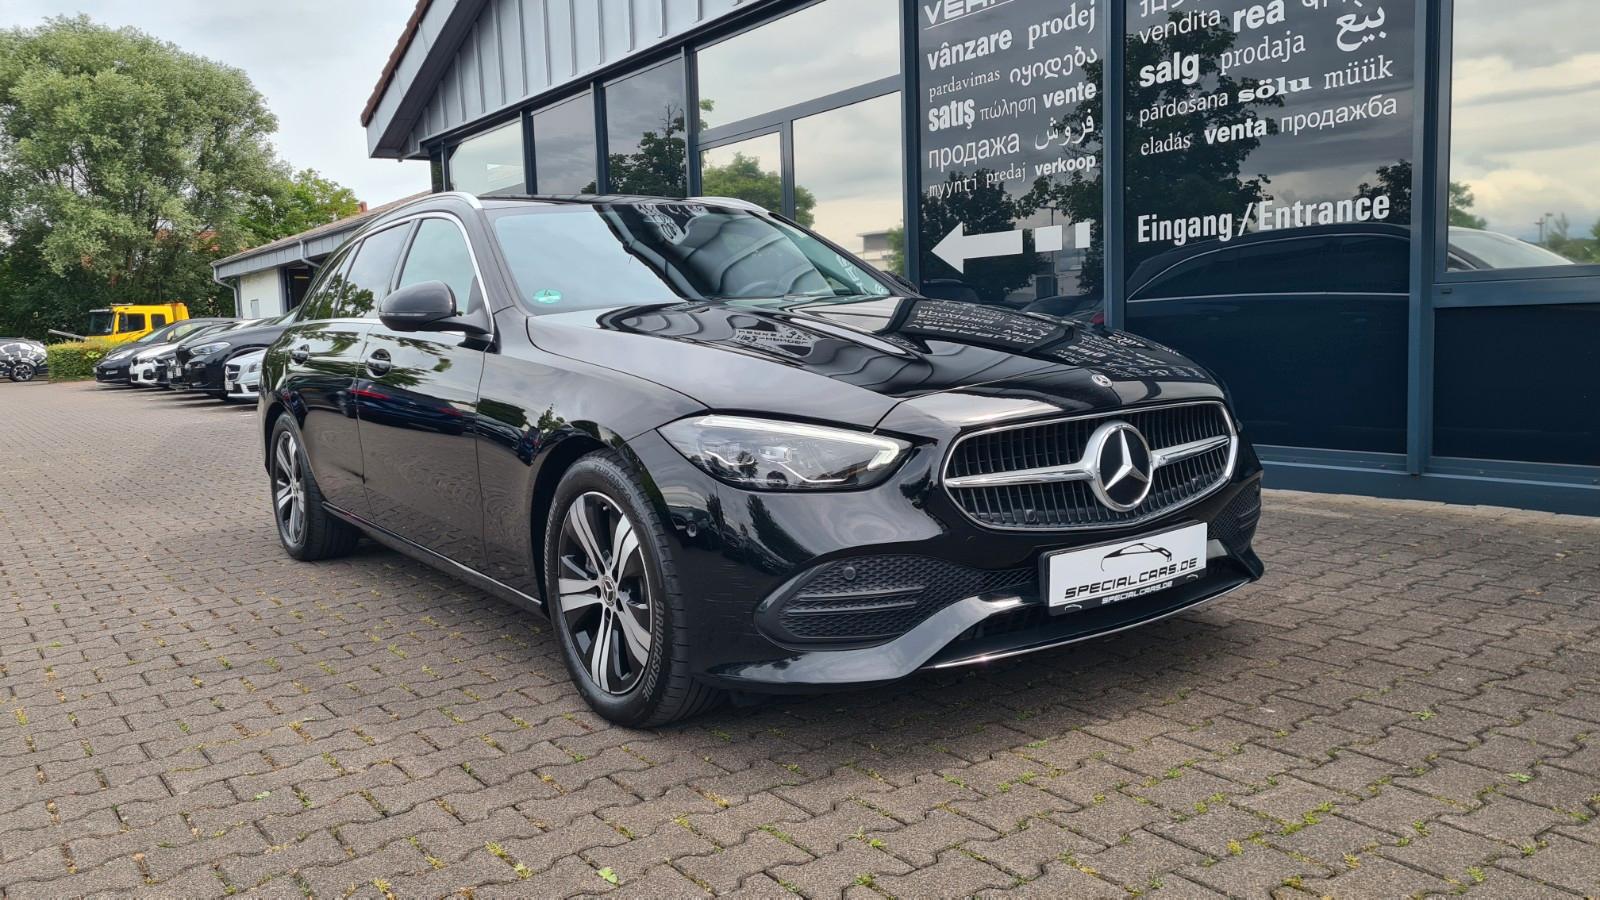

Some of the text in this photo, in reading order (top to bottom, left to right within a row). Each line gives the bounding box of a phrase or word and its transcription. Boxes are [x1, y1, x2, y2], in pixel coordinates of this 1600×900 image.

[927, 0, 1096, 71] vânzare prodej
[1139, 0, 1285, 44] vendita rea
[1336, 5, 1387, 52] بيع
[1139, 30, 1306, 88] salg prodaja
[929, 70, 1000, 102] pardavimas
[1042, 82, 1097, 109] vente
[1139, 54, 1393, 127] pārdošana sölu müük
[928, 98, 975, 132] satış
[980, 96, 1036, 121] πώληση
[1280, 94, 1397, 136] продажба
[928, 132, 1020, 173] продажа
[1140, 117, 1267, 157] eladás venta
[929, 153, 1096, 200] myynti predaj verkoop
[1137, 211, 1233, 246] Eingang
[1258, 193, 1390, 231] Entrance
[1064, 557, 1198, 599] SPECIALCARS.DE
